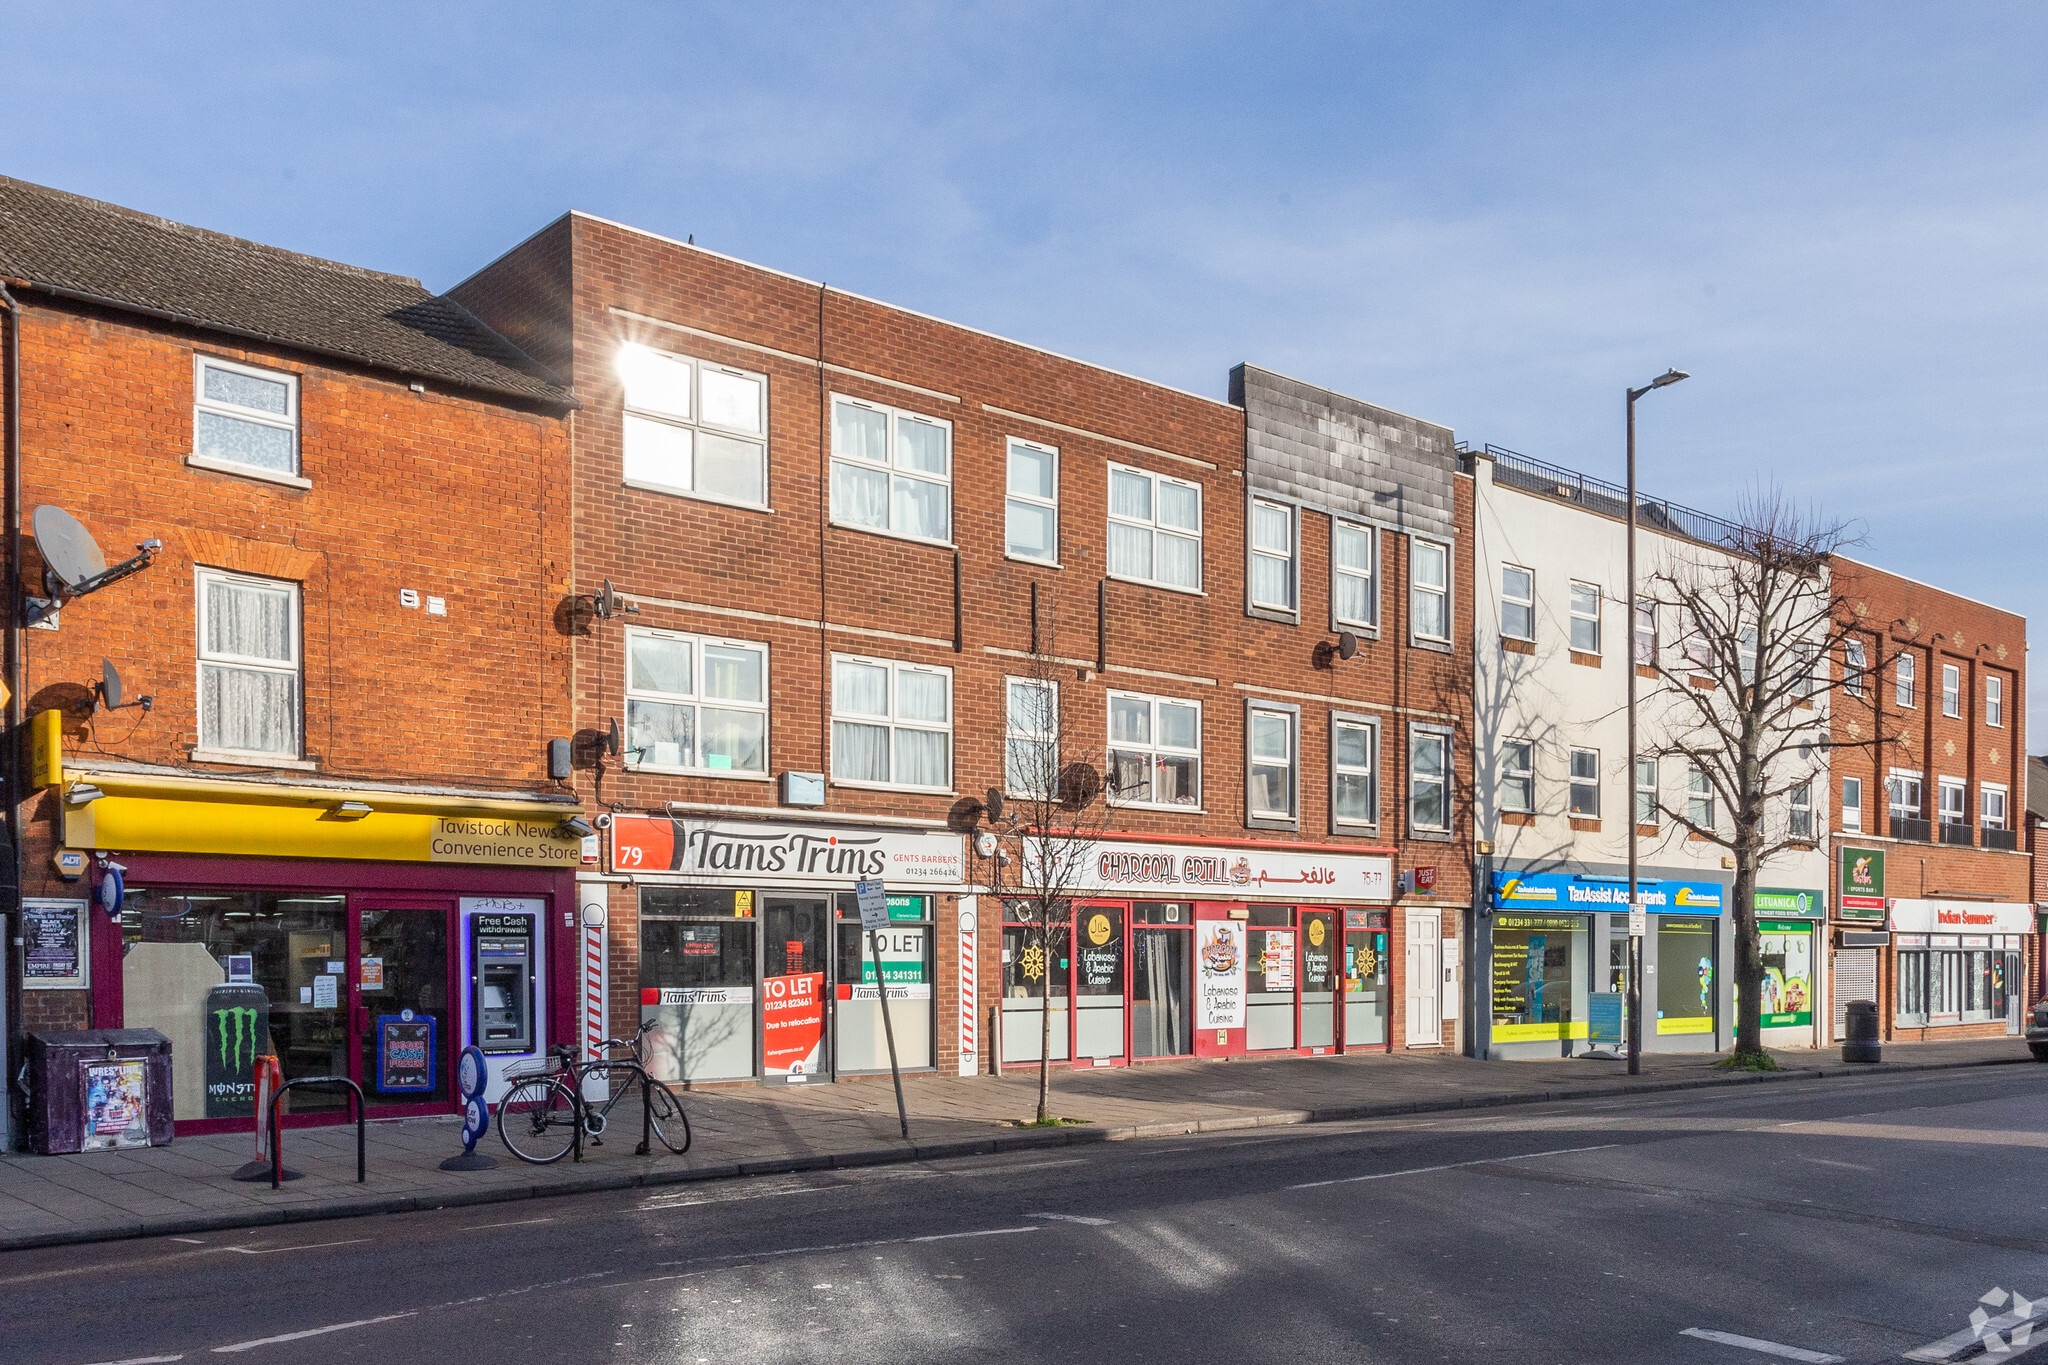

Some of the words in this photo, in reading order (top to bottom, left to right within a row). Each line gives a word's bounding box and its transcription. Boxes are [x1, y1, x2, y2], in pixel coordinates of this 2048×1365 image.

[438, 818, 511, 837] Tavistock
[516, 822, 557, 839] News
[432, 838, 533, 858] Convenience
[539, 844, 578, 860] Store
[689, 829, 790, 872] Tams
[789, 833, 886, 875] Trims
[62, 856, 81, 865] ADT
[620, 846, 643, 866] 79
[893, 854, 920, 863] GENTS
[922, 855, 958, 865] BARBERS
[905, 868, 927, 877] 01234
[1098, 852, 1180, 885] CHARCOAL
[1182, 855, 1230, 885] GRILL
[1418, 869, 1434, 877] JUST
[1362, 871, 1382, 885] 75-77
[1421, 876, 1434, 884] EAT
[859, 883, 866, 894] P
[1568, 886, 1612, 905] TaxAssist
[1613, 888, 1666, 906] Accuntants
[1757, 896, 1796, 908] LITUANICA
[479, 916, 500, 926] Free
[503, 916, 527, 926] Cash
[1938, 909, 1961, 924] Indian
[1962, 909, 1994, 925] Summer
[479, 926, 527, 934] withdrawals
[865, 934, 887, 952] TO
[893, 935, 923, 952] LET
[1084, 949, 1116, 961] Lebanese
[1305, 951, 1328, 962] Lebanese
[1085, 961, 1091, 973] &
[1092, 961, 1114, 973] Arabic
[865, 970, 892, 980] 0134
[893, 970, 922, 980] 341311
[1088, 973, 1111, 985] Cuisine
[764, 980, 786, 998] TO
[790, 977, 813, 996] LET
[854, 986, 880, 998] Tams
[1203, 984, 1238, 997] Lebanese
[663, 990, 697, 1003] Tams
[694, 990, 727, 1003] Trims
[765, 1001, 787, 1011] 01234
[788, 997, 813, 1008] 823661
[1206, 997, 1211, 1010] &
[1214, 997, 1236, 1010] Arabic
[766, 1022, 779, 1030] Due
[780, 1020, 788, 1028] to
[788, 1017, 820, 1027] relocation
[1209, 1011, 1233, 1024] Cuisine
[1219, 1031, 1225, 1043] H
[389, 1050, 424, 1059] CASH
[389, 1059, 424, 1067] PRIZES
[209, 1082, 255, 1095] MONST
